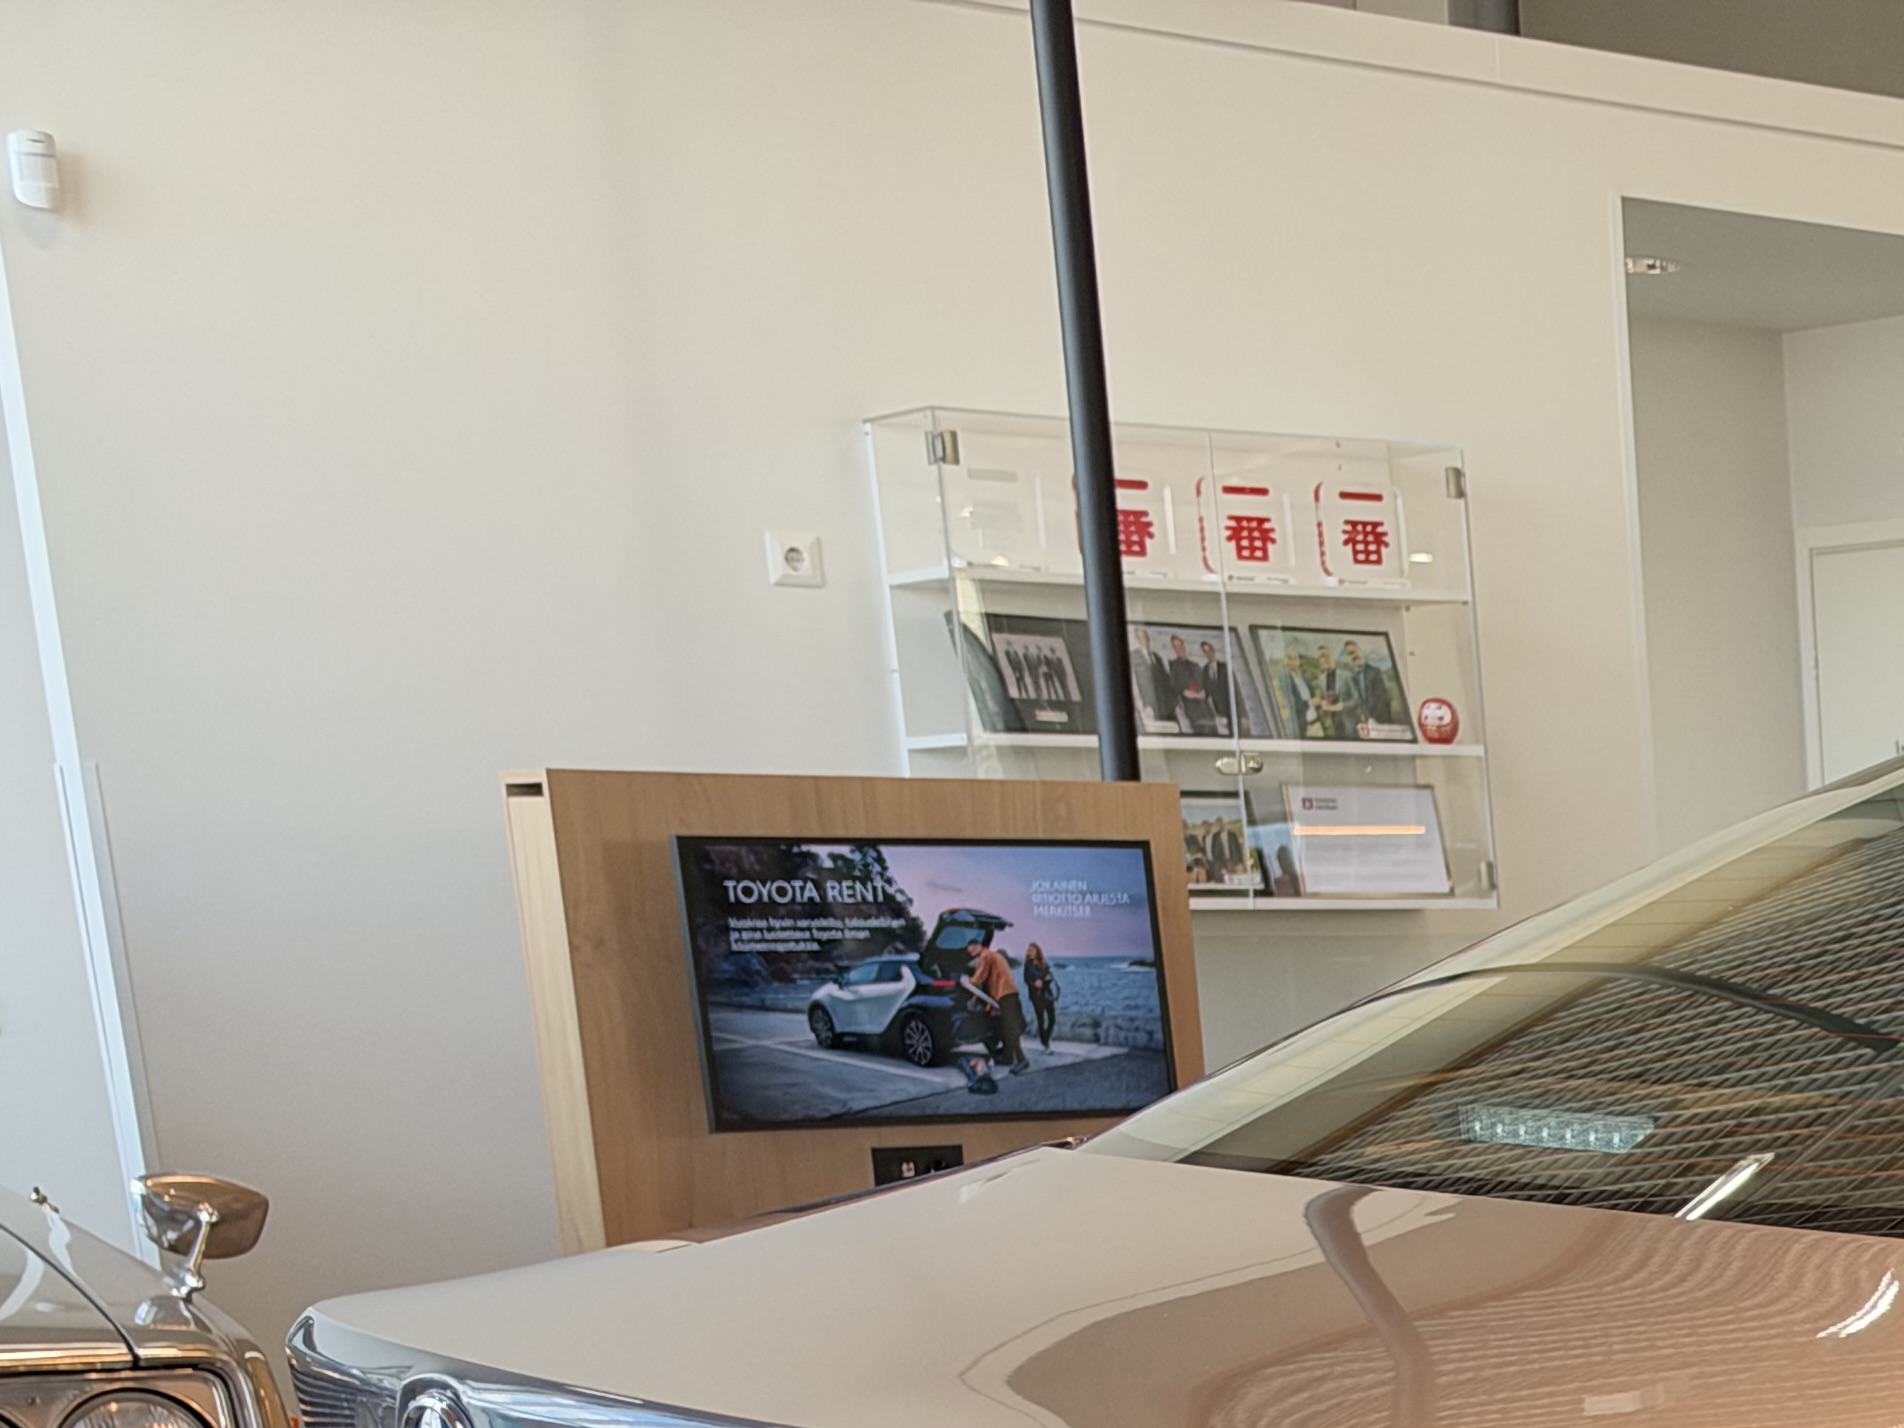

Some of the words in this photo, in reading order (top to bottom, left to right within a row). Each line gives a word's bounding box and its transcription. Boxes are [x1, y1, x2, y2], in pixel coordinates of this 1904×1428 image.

[1220, 484, 1278, 563] 一番
[1337, 490, 1390, 566] 一番
[722, 879, 821, 904] TOYOTA
[826, 879, 885, 903] RENT
